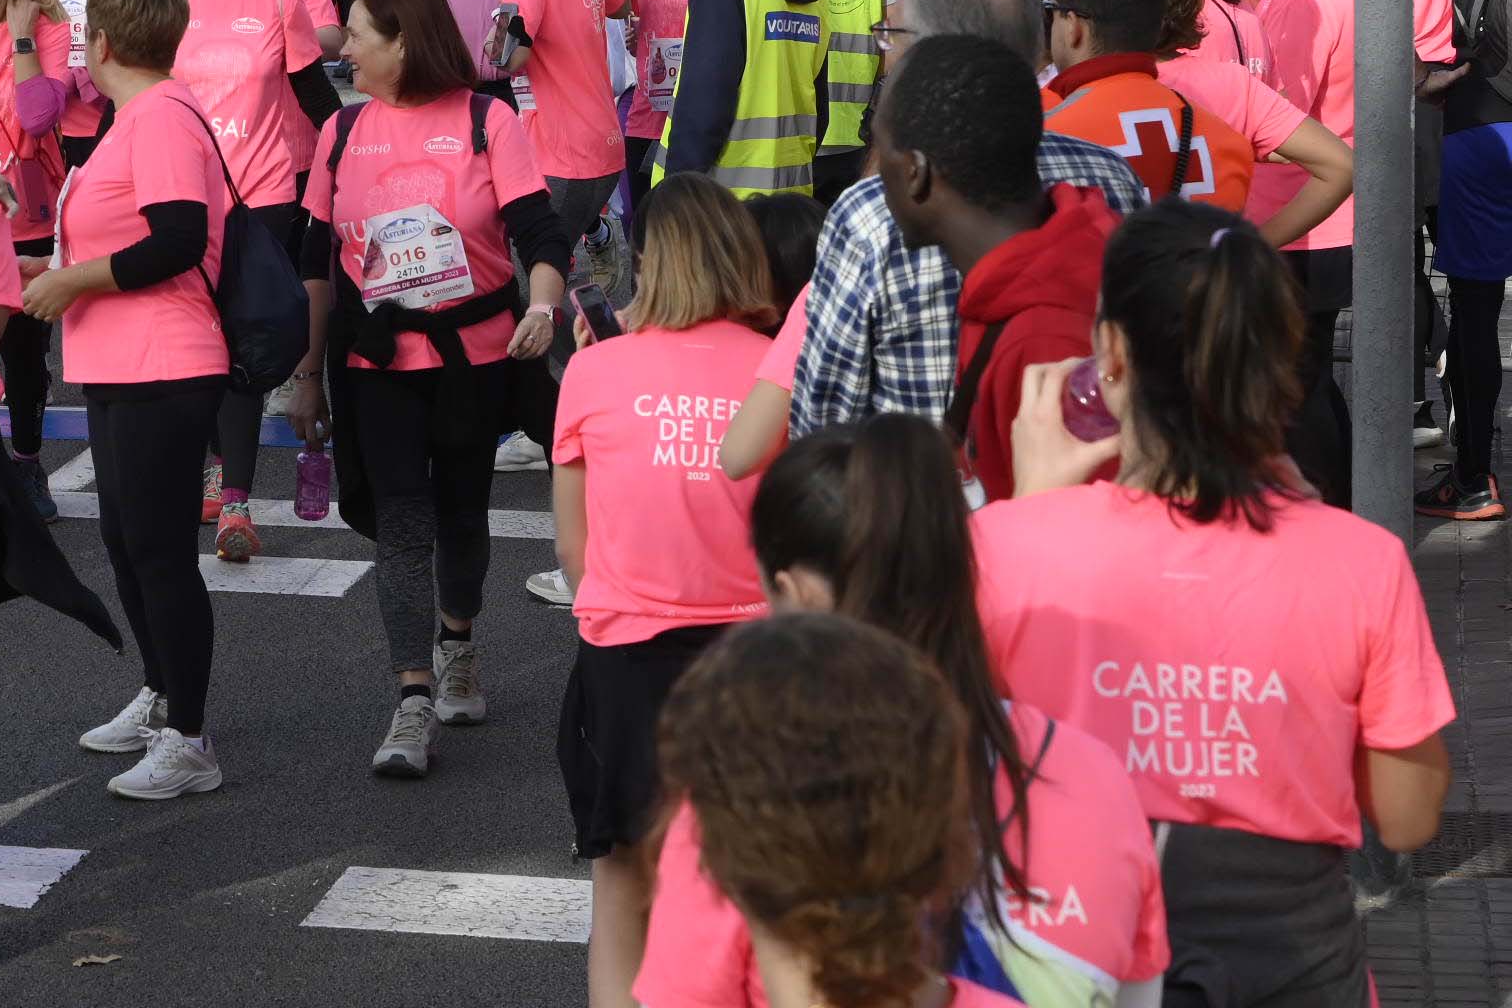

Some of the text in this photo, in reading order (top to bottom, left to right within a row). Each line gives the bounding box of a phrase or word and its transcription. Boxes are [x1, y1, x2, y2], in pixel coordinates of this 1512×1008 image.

[350, 144, 391, 156] OYSHO
[339, 220, 366, 244] TU
[381, 223, 423, 241] ASTURIANA
[390, 246, 426, 266] 016
[396, 265, 426, 279] 24710
[659, 418, 694, 442] DE
[653, 443, 722, 469] MUJE
[1092, 661, 1288, 704] CARRERA
[1132, 701, 1251, 739] DE LA
[1126, 738, 1260, 778] MUJER
